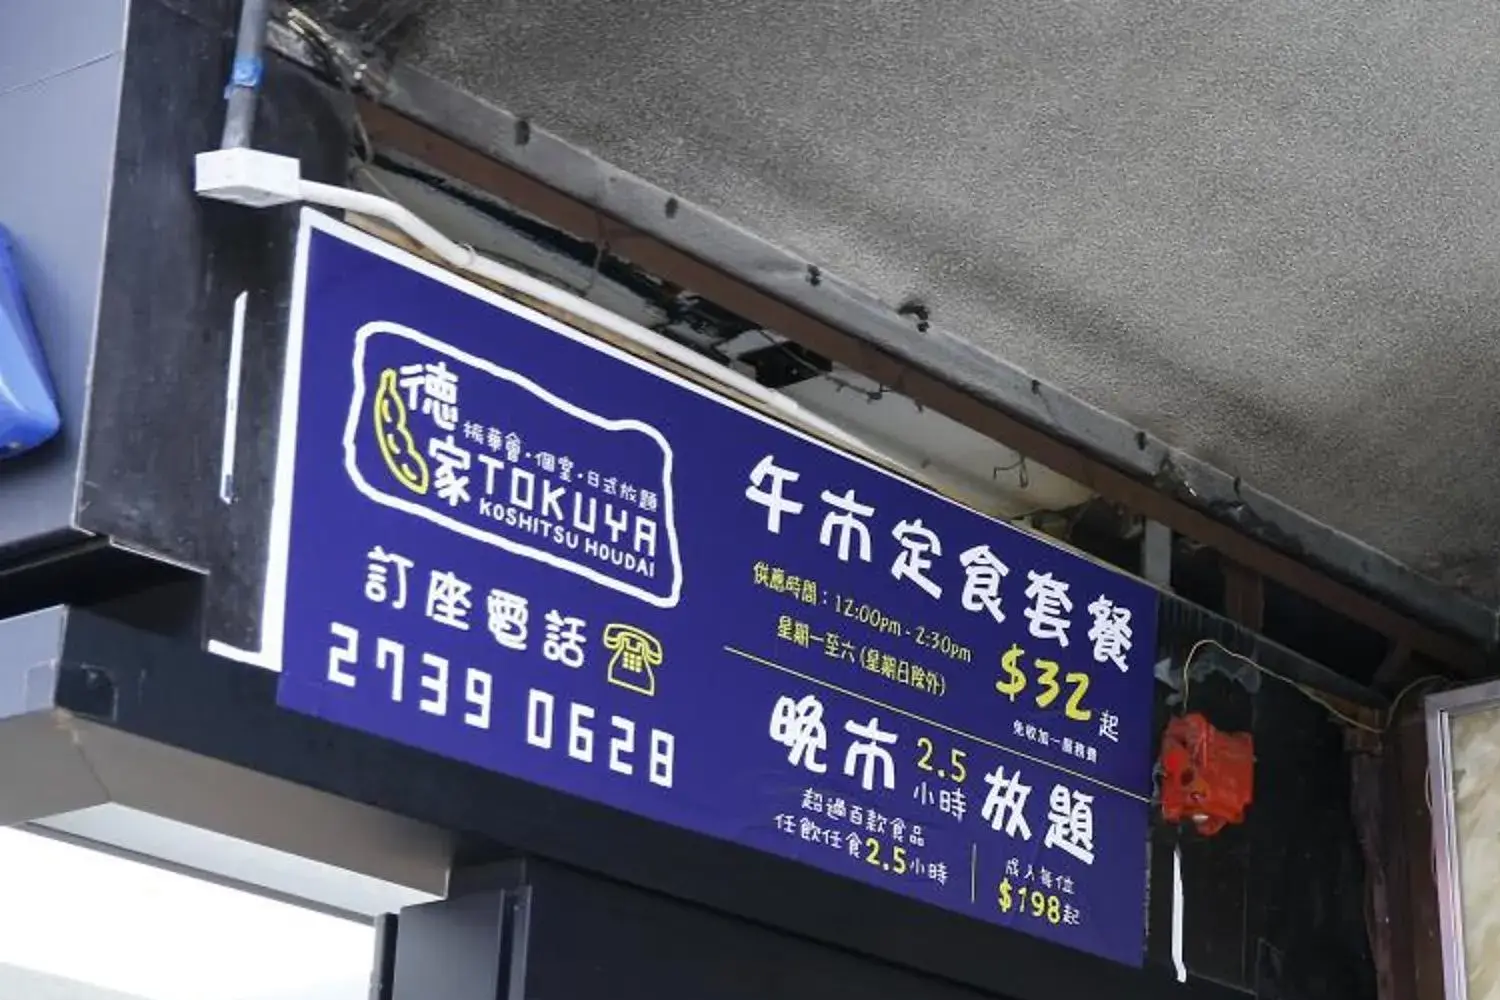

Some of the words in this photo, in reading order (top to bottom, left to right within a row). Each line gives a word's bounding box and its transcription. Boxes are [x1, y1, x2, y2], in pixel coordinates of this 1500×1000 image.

[399, 361, 472, 507] 德家
[478, 454, 657, 557] TOKUYA
[479, 498, 580, 549] KOSHITSU
[585, 537, 655, 578] HOUDAI
[363, 545, 588, 668] 訂座電話
[745, 455, 1133, 673] 午市定食套餐
[914, 624, 972, 663] 2:30pm
[996, 643, 1092, 722] $32
[327, 621, 493, 729] 2739
[527, 688, 675, 788] 0628
[769, 693, 899, 791] 晚市
[981, 764, 1096, 866] 放題
[912, 780, 967, 823] 小時
[916, 736, 968, 784] 2.5
